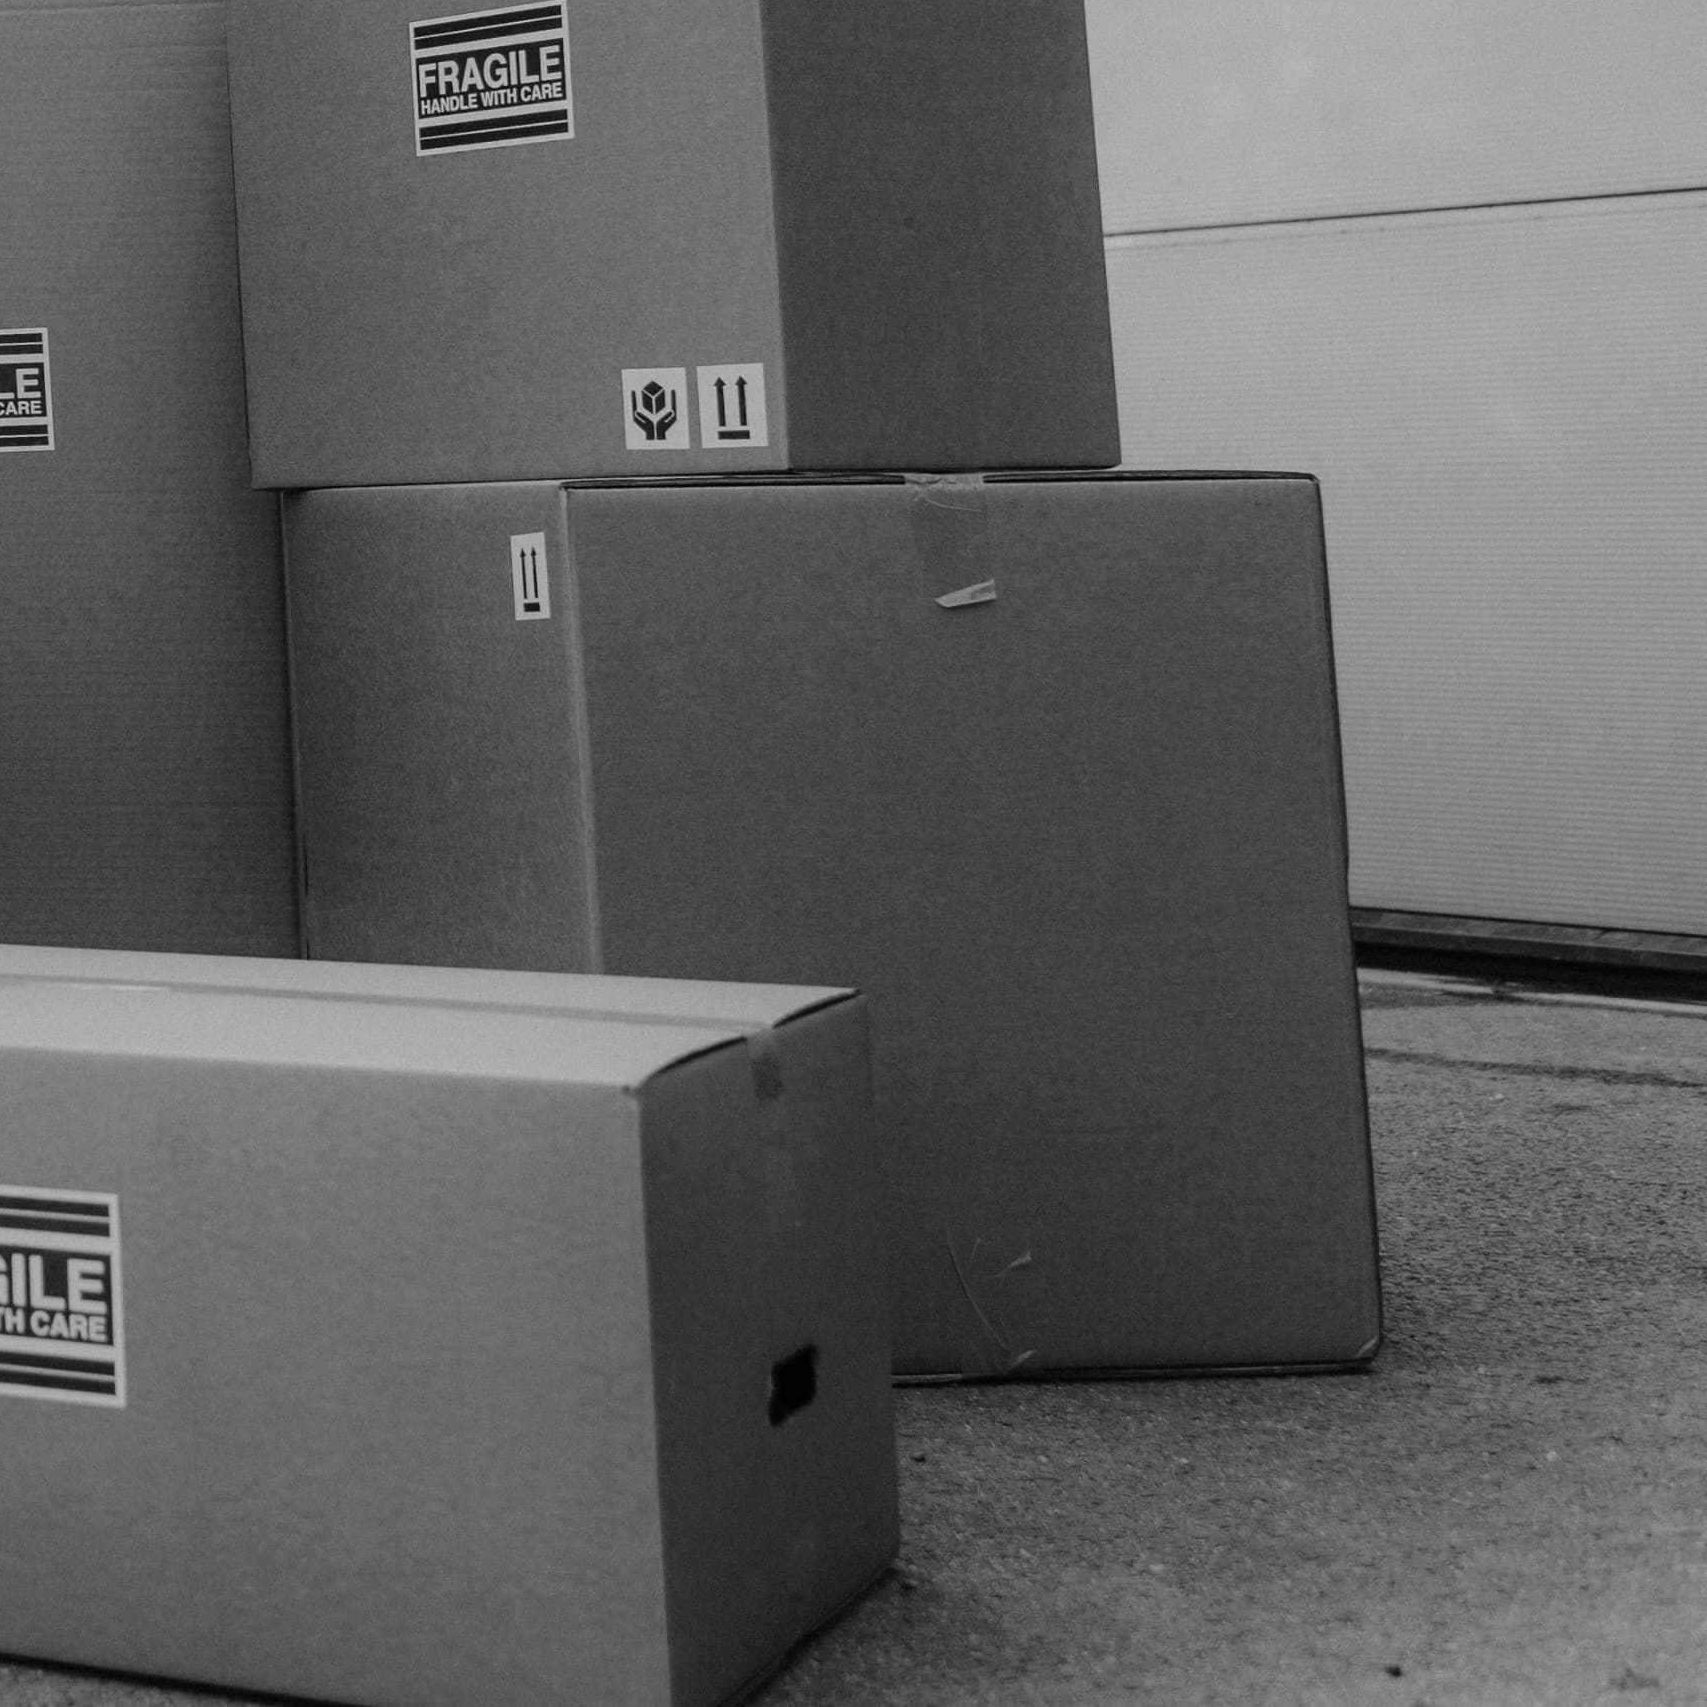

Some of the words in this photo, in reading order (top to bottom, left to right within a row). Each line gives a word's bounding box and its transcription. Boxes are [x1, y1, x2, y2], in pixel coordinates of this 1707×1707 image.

[419, 45, 562, 98] FRAGILE
[420, 93, 478, 115] HANDLE
[480, 88, 518, 107] WITH
[520, 82, 563, 102] CARE
[29, 1309, 108, 1343] CARE
